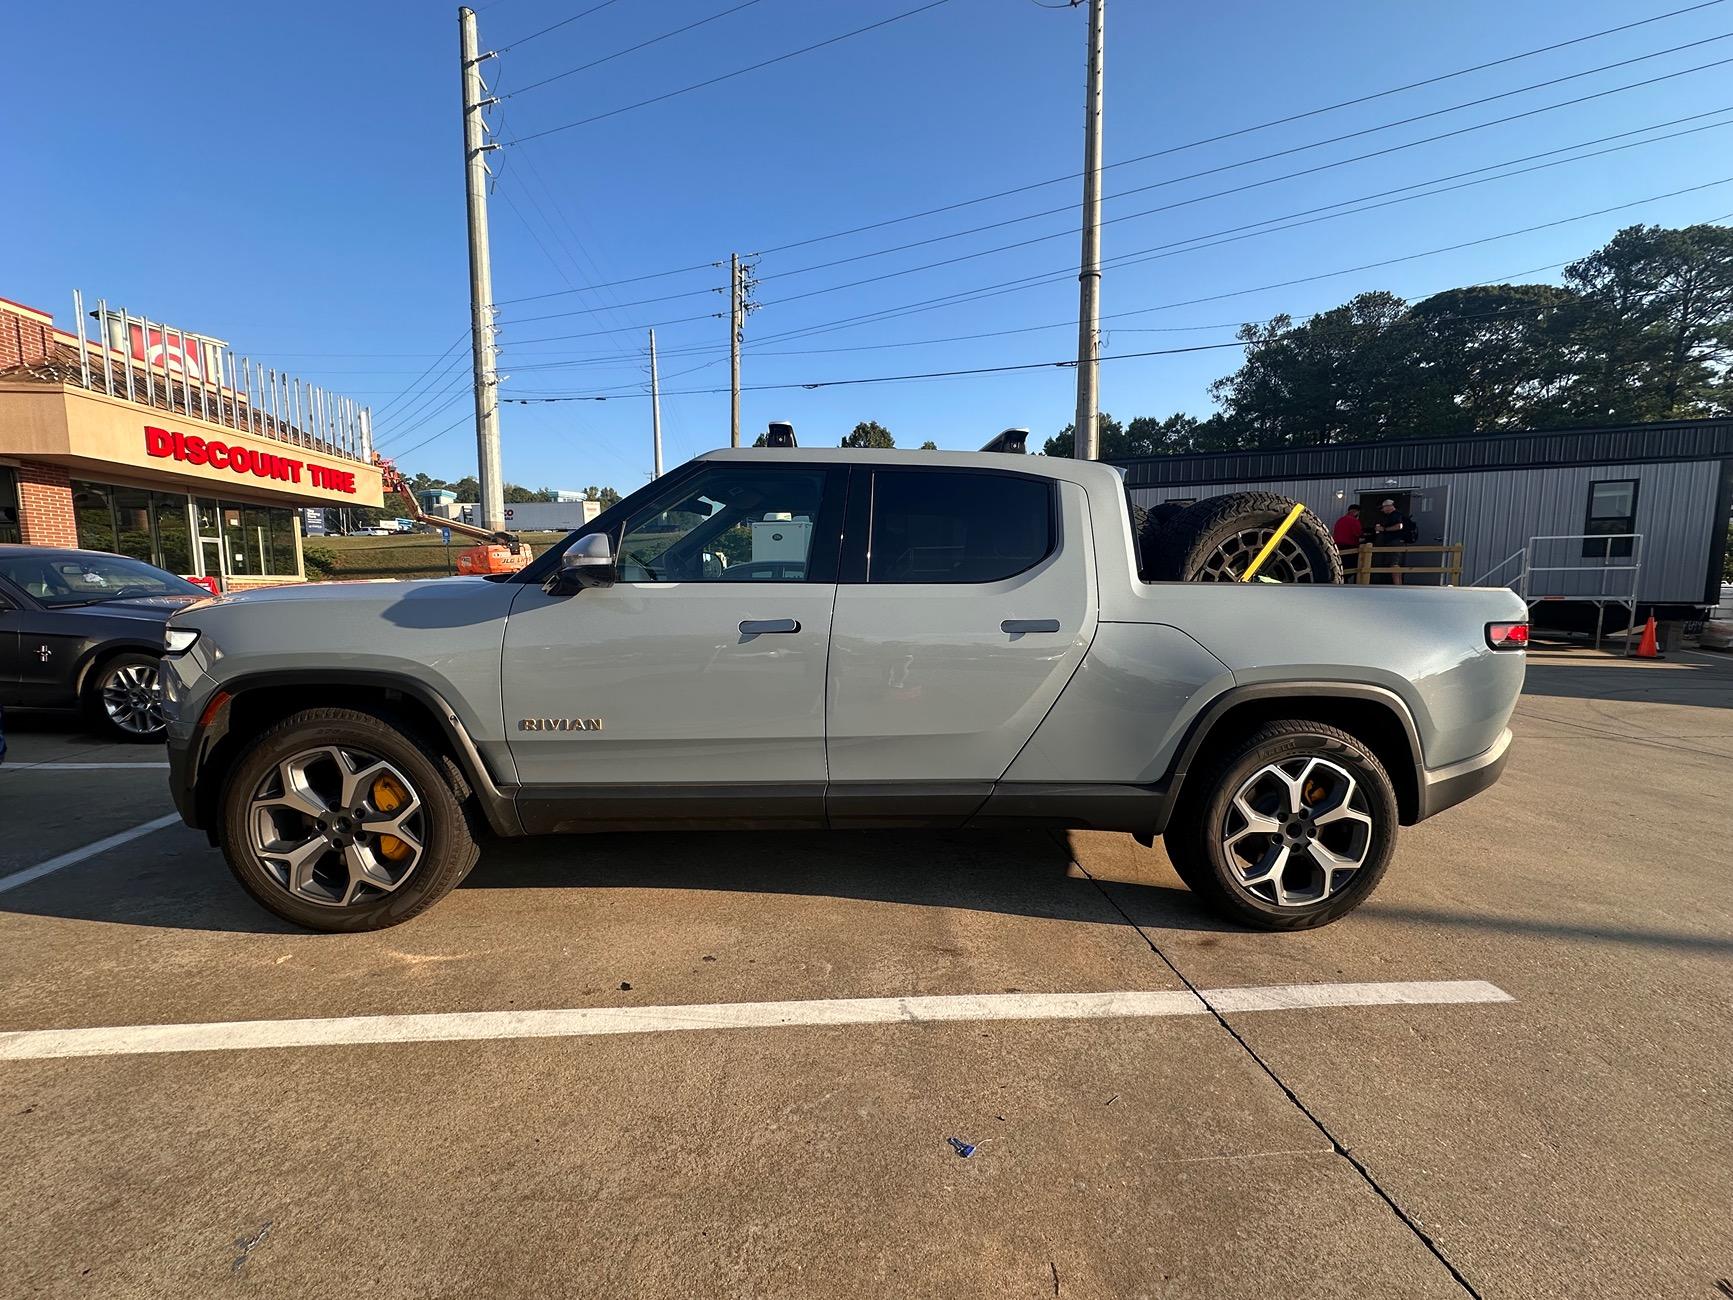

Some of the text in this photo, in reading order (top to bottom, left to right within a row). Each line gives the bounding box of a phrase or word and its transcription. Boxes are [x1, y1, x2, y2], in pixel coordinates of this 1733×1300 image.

[144, 426, 357, 494] DISCOUNT TIRE
[518, 718, 603, 732] RIVIAN
